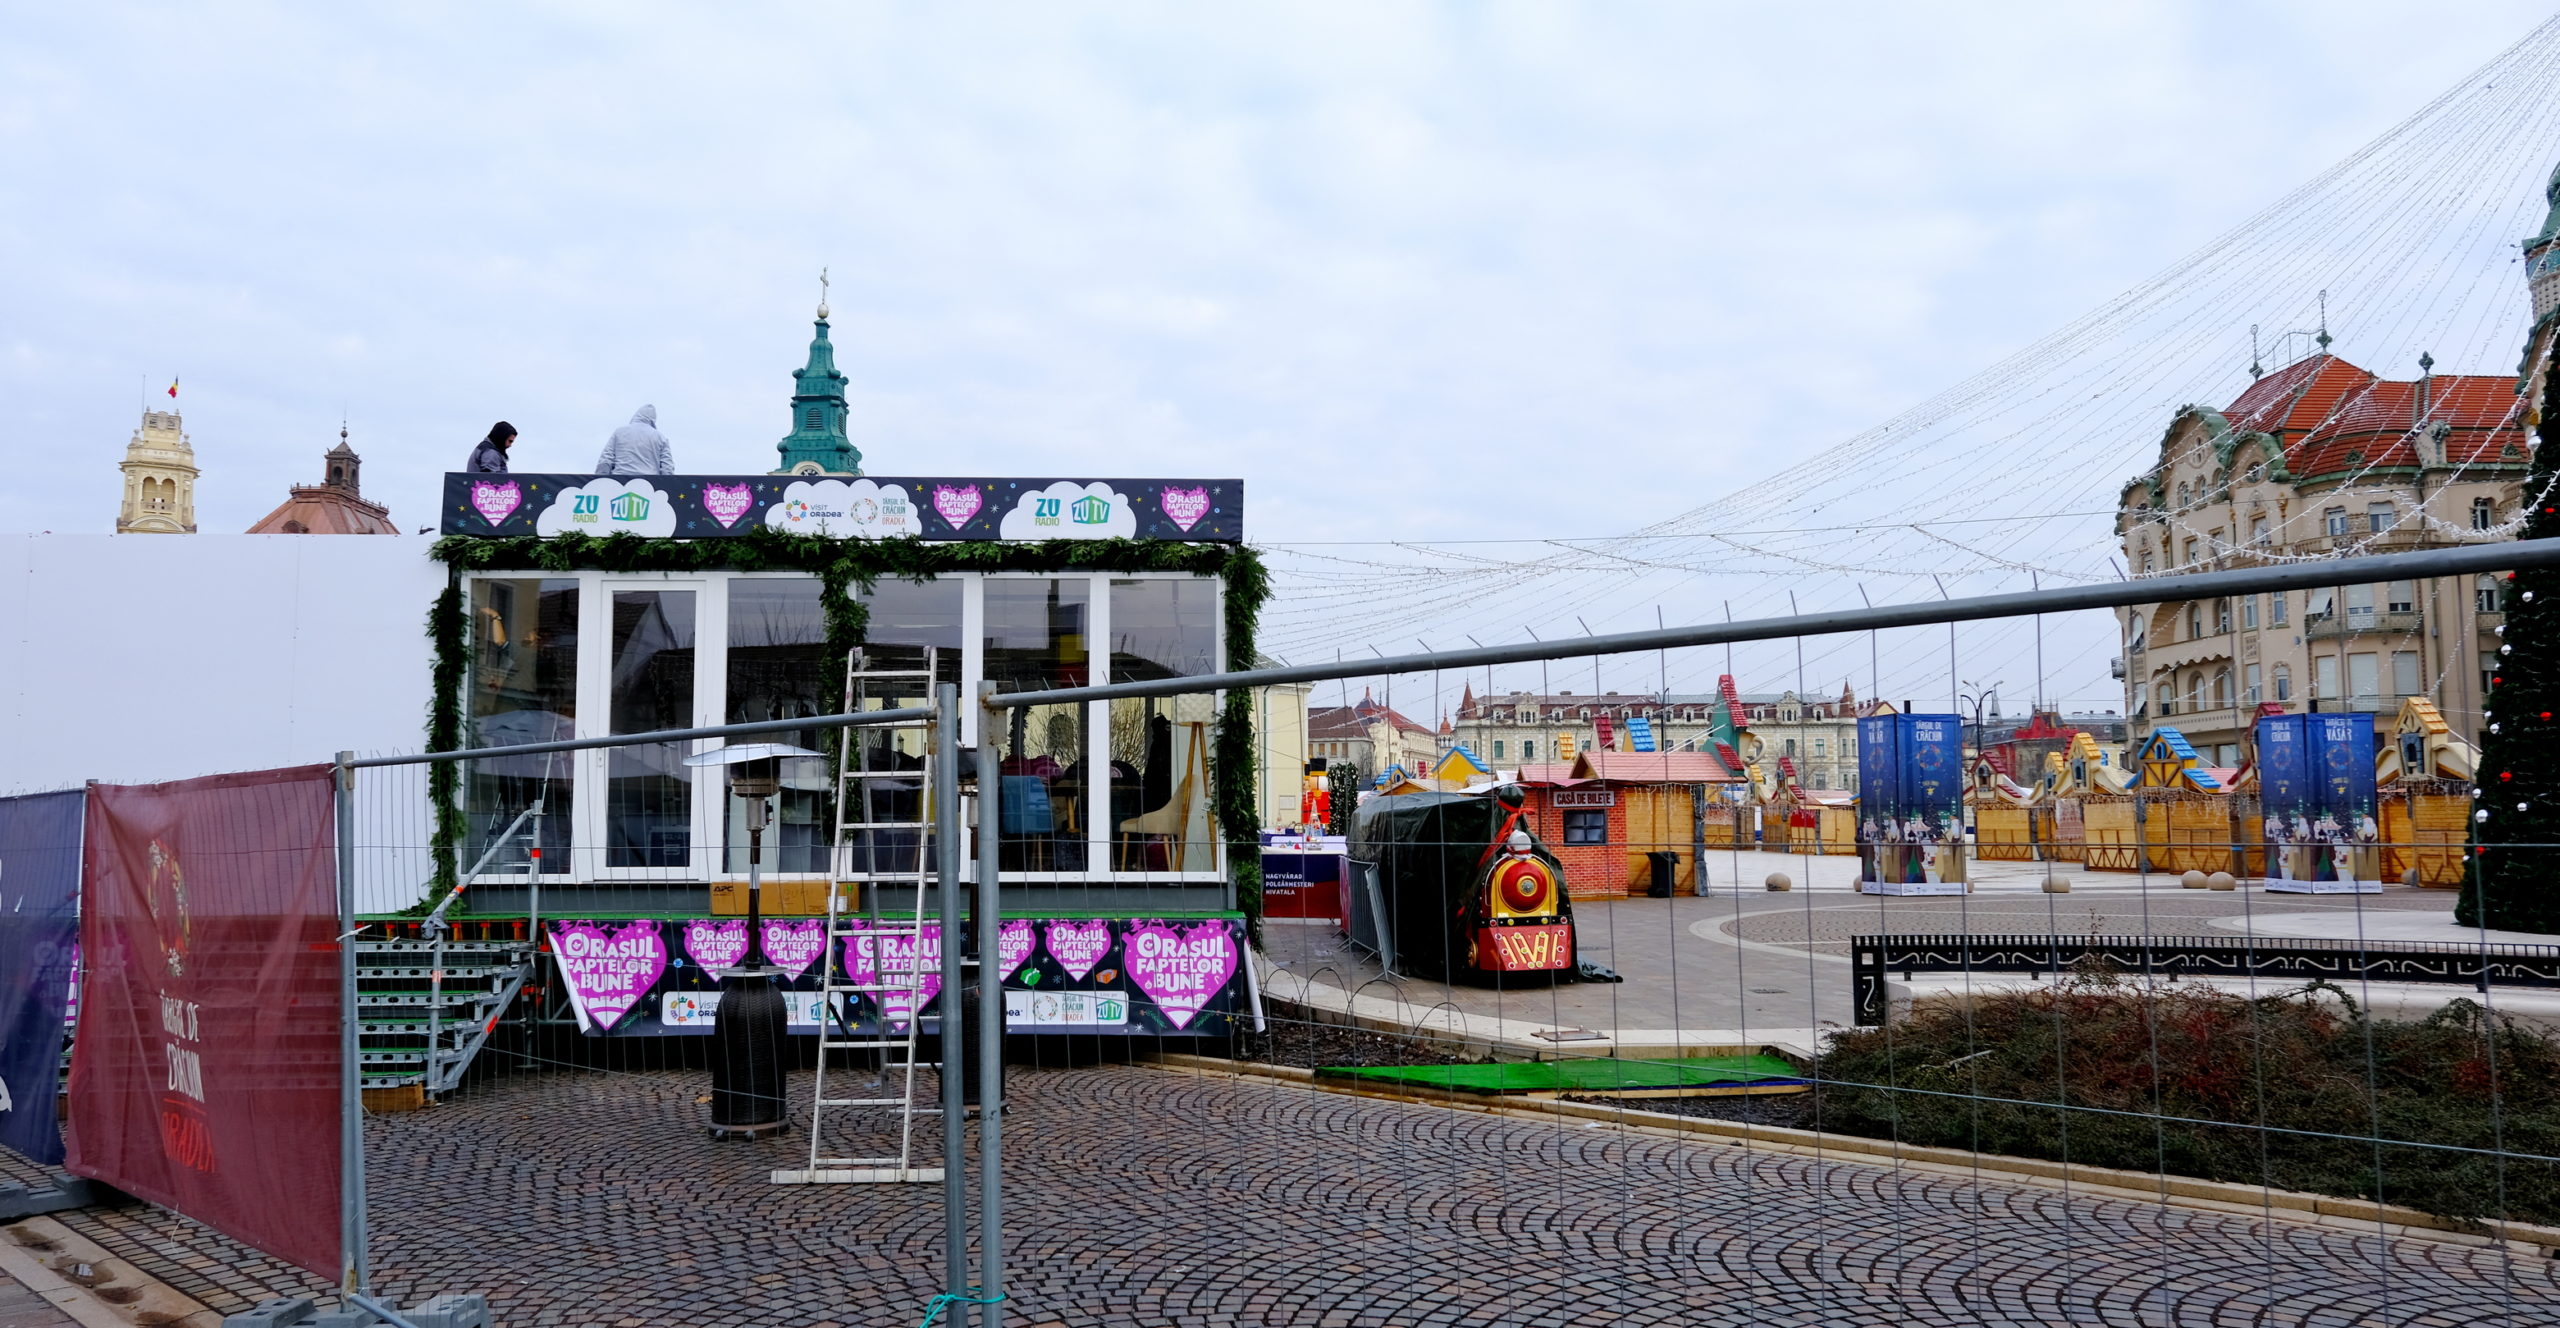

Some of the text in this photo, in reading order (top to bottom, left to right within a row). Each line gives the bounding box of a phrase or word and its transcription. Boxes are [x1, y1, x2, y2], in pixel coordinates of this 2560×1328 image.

[573, 495, 600, 514] ZU
[1035, 498, 1061, 517] ZU
[572, 514, 598, 523] RADIO
[1035, 517, 1060, 526] RADIO
[1557, 792, 1576, 804] CASĂ
[1576, 793, 1586, 804] DE
[1265, 872, 1303, 880] NAGYVÁRAD
[691, 941, 742, 951] FAPTELOR
[767, 941, 818, 951] FAPTELOR
[1052, 941, 1104, 951] FAPTELOR
[701, 950, 732, 961] BUNE
[777, 950, 808, 961] BUNE
[1062, 950, 1092, 961] BUNE
[1136, 958, 1224, 975] FAPTELOR
[581, 973, 634, 993] BUNE
[1153, 973, 1205, 992] BUNE
[186, 1001, 200, 1043] DE
[162, 1111, 215, 1173] ORADEA
